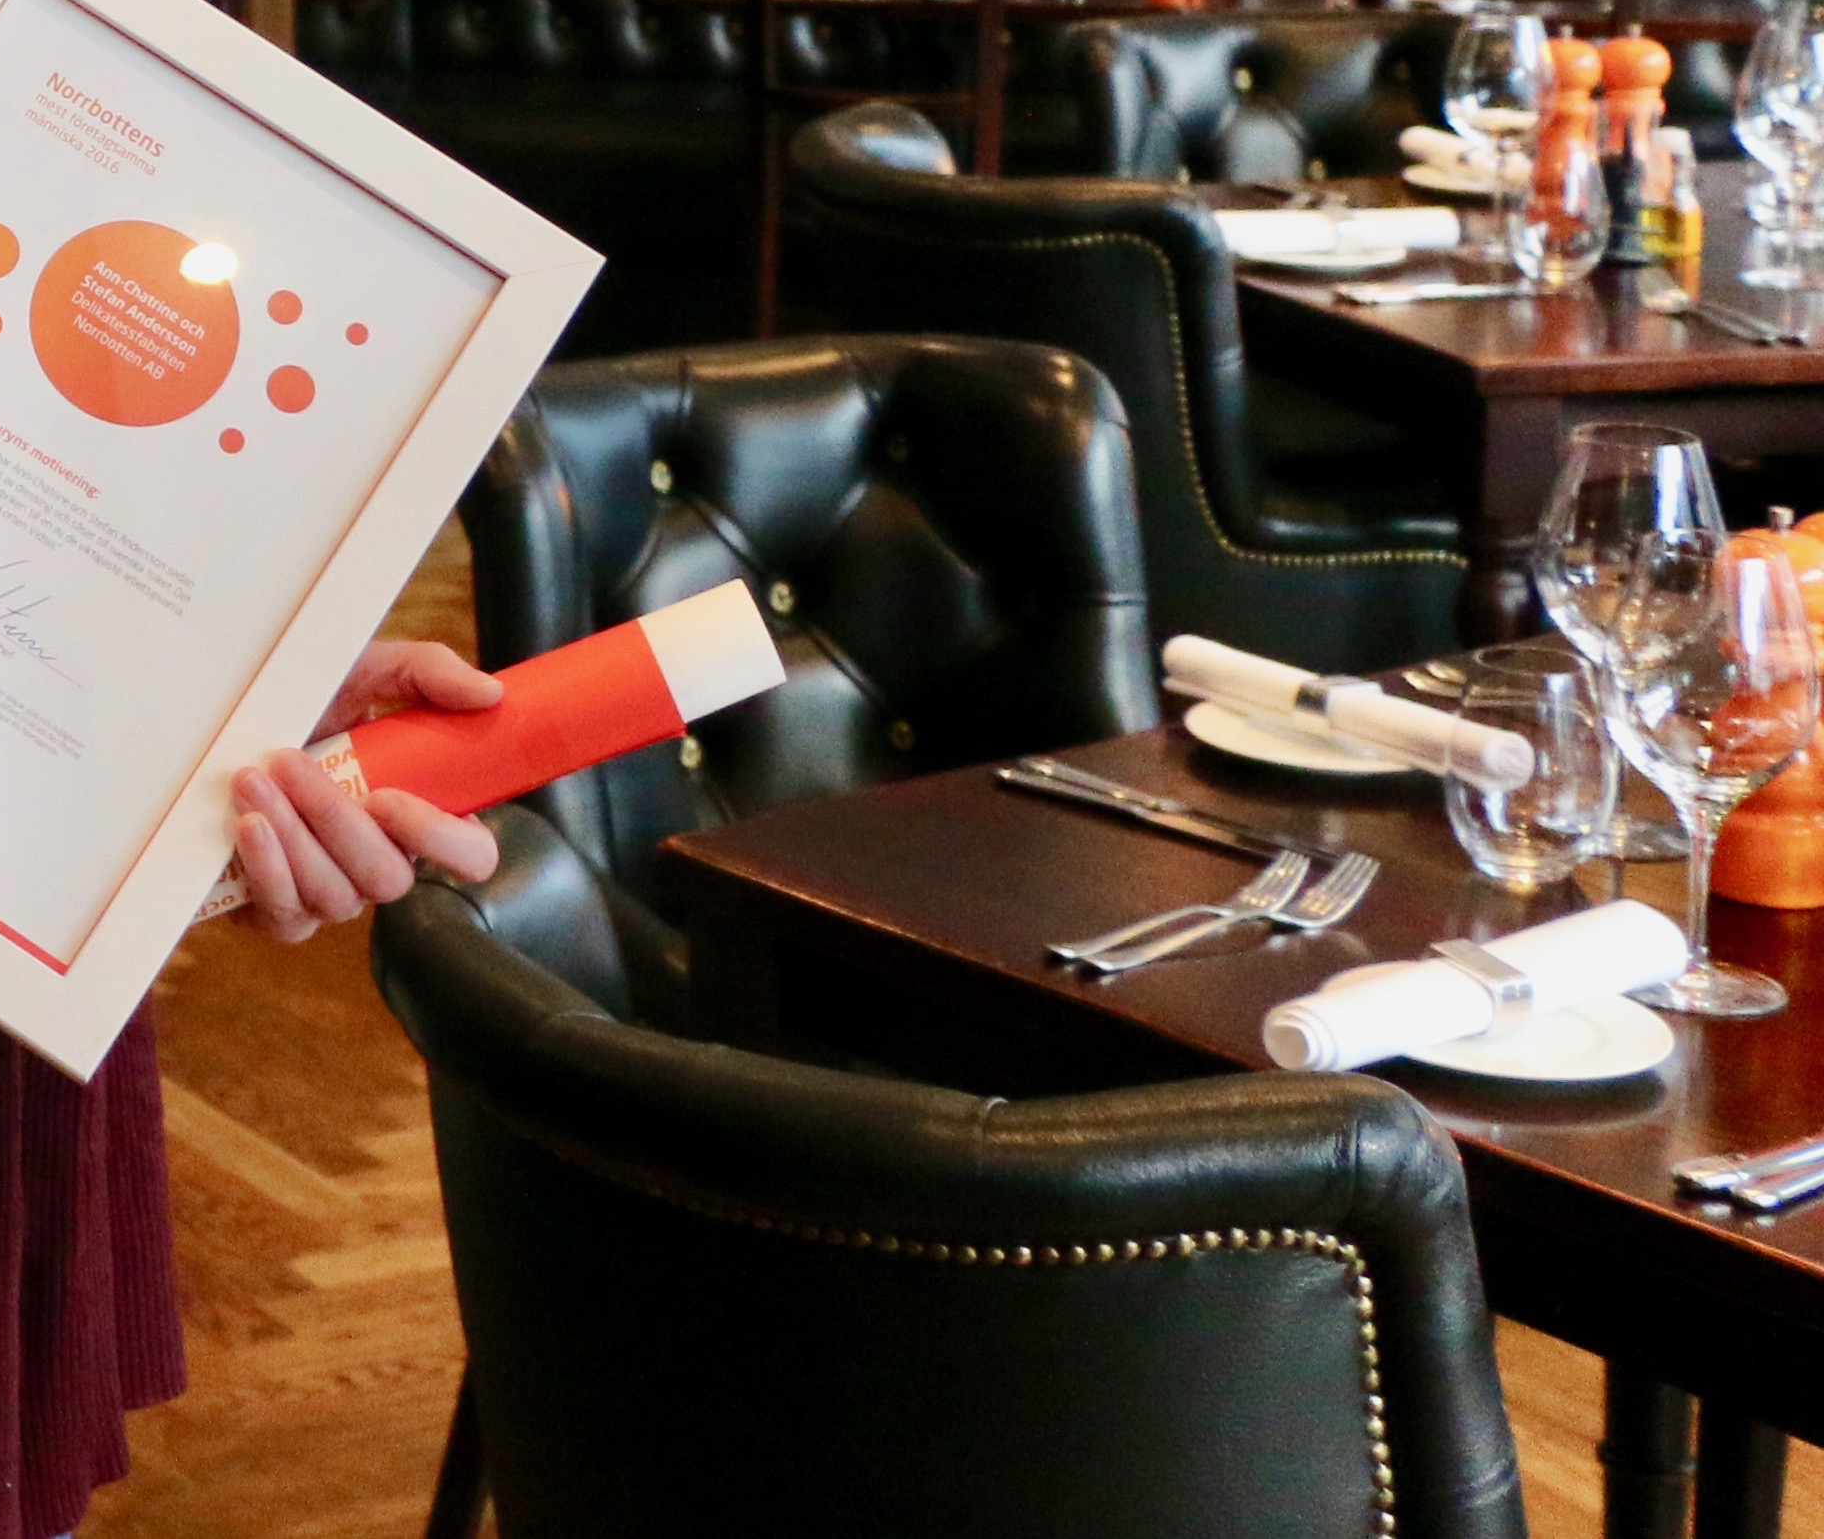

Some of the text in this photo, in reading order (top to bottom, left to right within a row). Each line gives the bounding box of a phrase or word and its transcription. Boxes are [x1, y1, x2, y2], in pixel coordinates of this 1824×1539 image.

[23, 104, 123, 176] människa 2016
[33, 90, 159, 178] mest företagsamma
[45, 71, 166, 157] Norrbottens
[69, 288, 189, 373] Delikatessfabriken
[80, 272, 200, 358] Stefan Andersson
[91, 257, 207, 340] Ann-Chatrine och
[71, 311, 167, 381] Norrbotten AB
